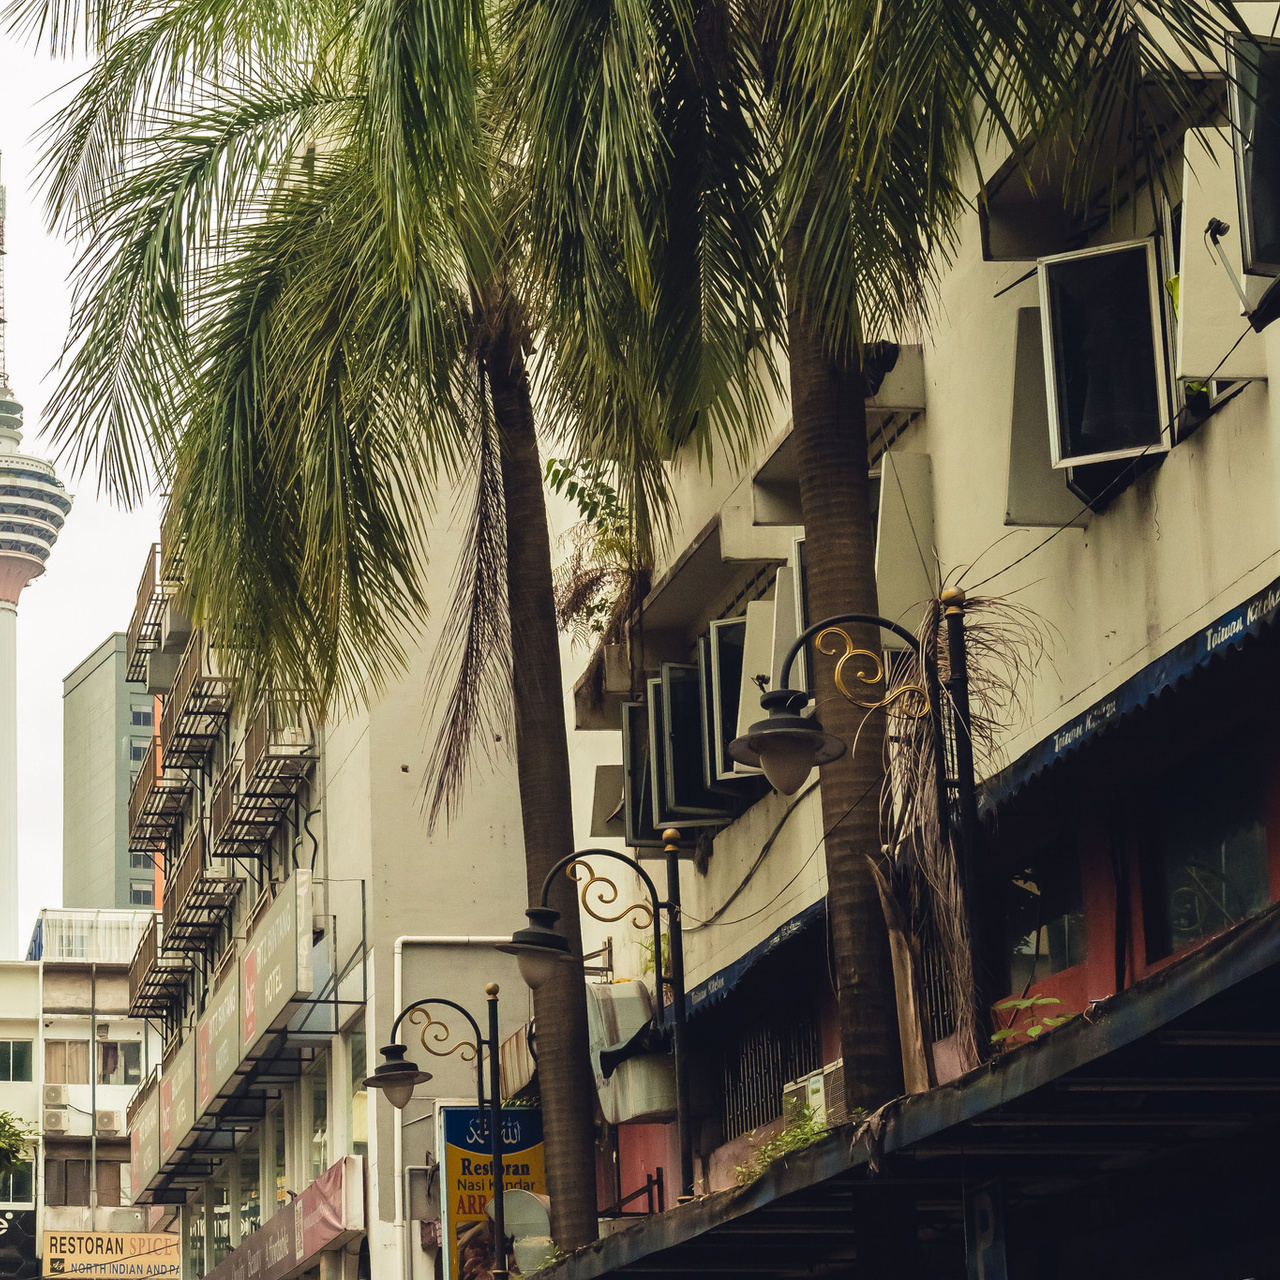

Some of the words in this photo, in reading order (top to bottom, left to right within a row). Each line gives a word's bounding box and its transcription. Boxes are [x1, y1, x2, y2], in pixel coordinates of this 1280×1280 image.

[1206, 616, 1244, 651] Taiwan
[1053, 723, 1083, 753] Taiwan
[263, 963, 283, 1010] HOTEL
[457, 1179, 485, 1191] Nasi
[488, 1179, 536, 1191] Kndar
[456, 1195, 494, 1215] ARR
[50, 1236, 124, 1255] RESTORAN
[129, 1237, 172, 1256] SPICE
[71, 1263, 106, 1275] NORTH
[109, 1263, 143, 1275] INDIAN
[146, 1264, 167, 1275] AND
